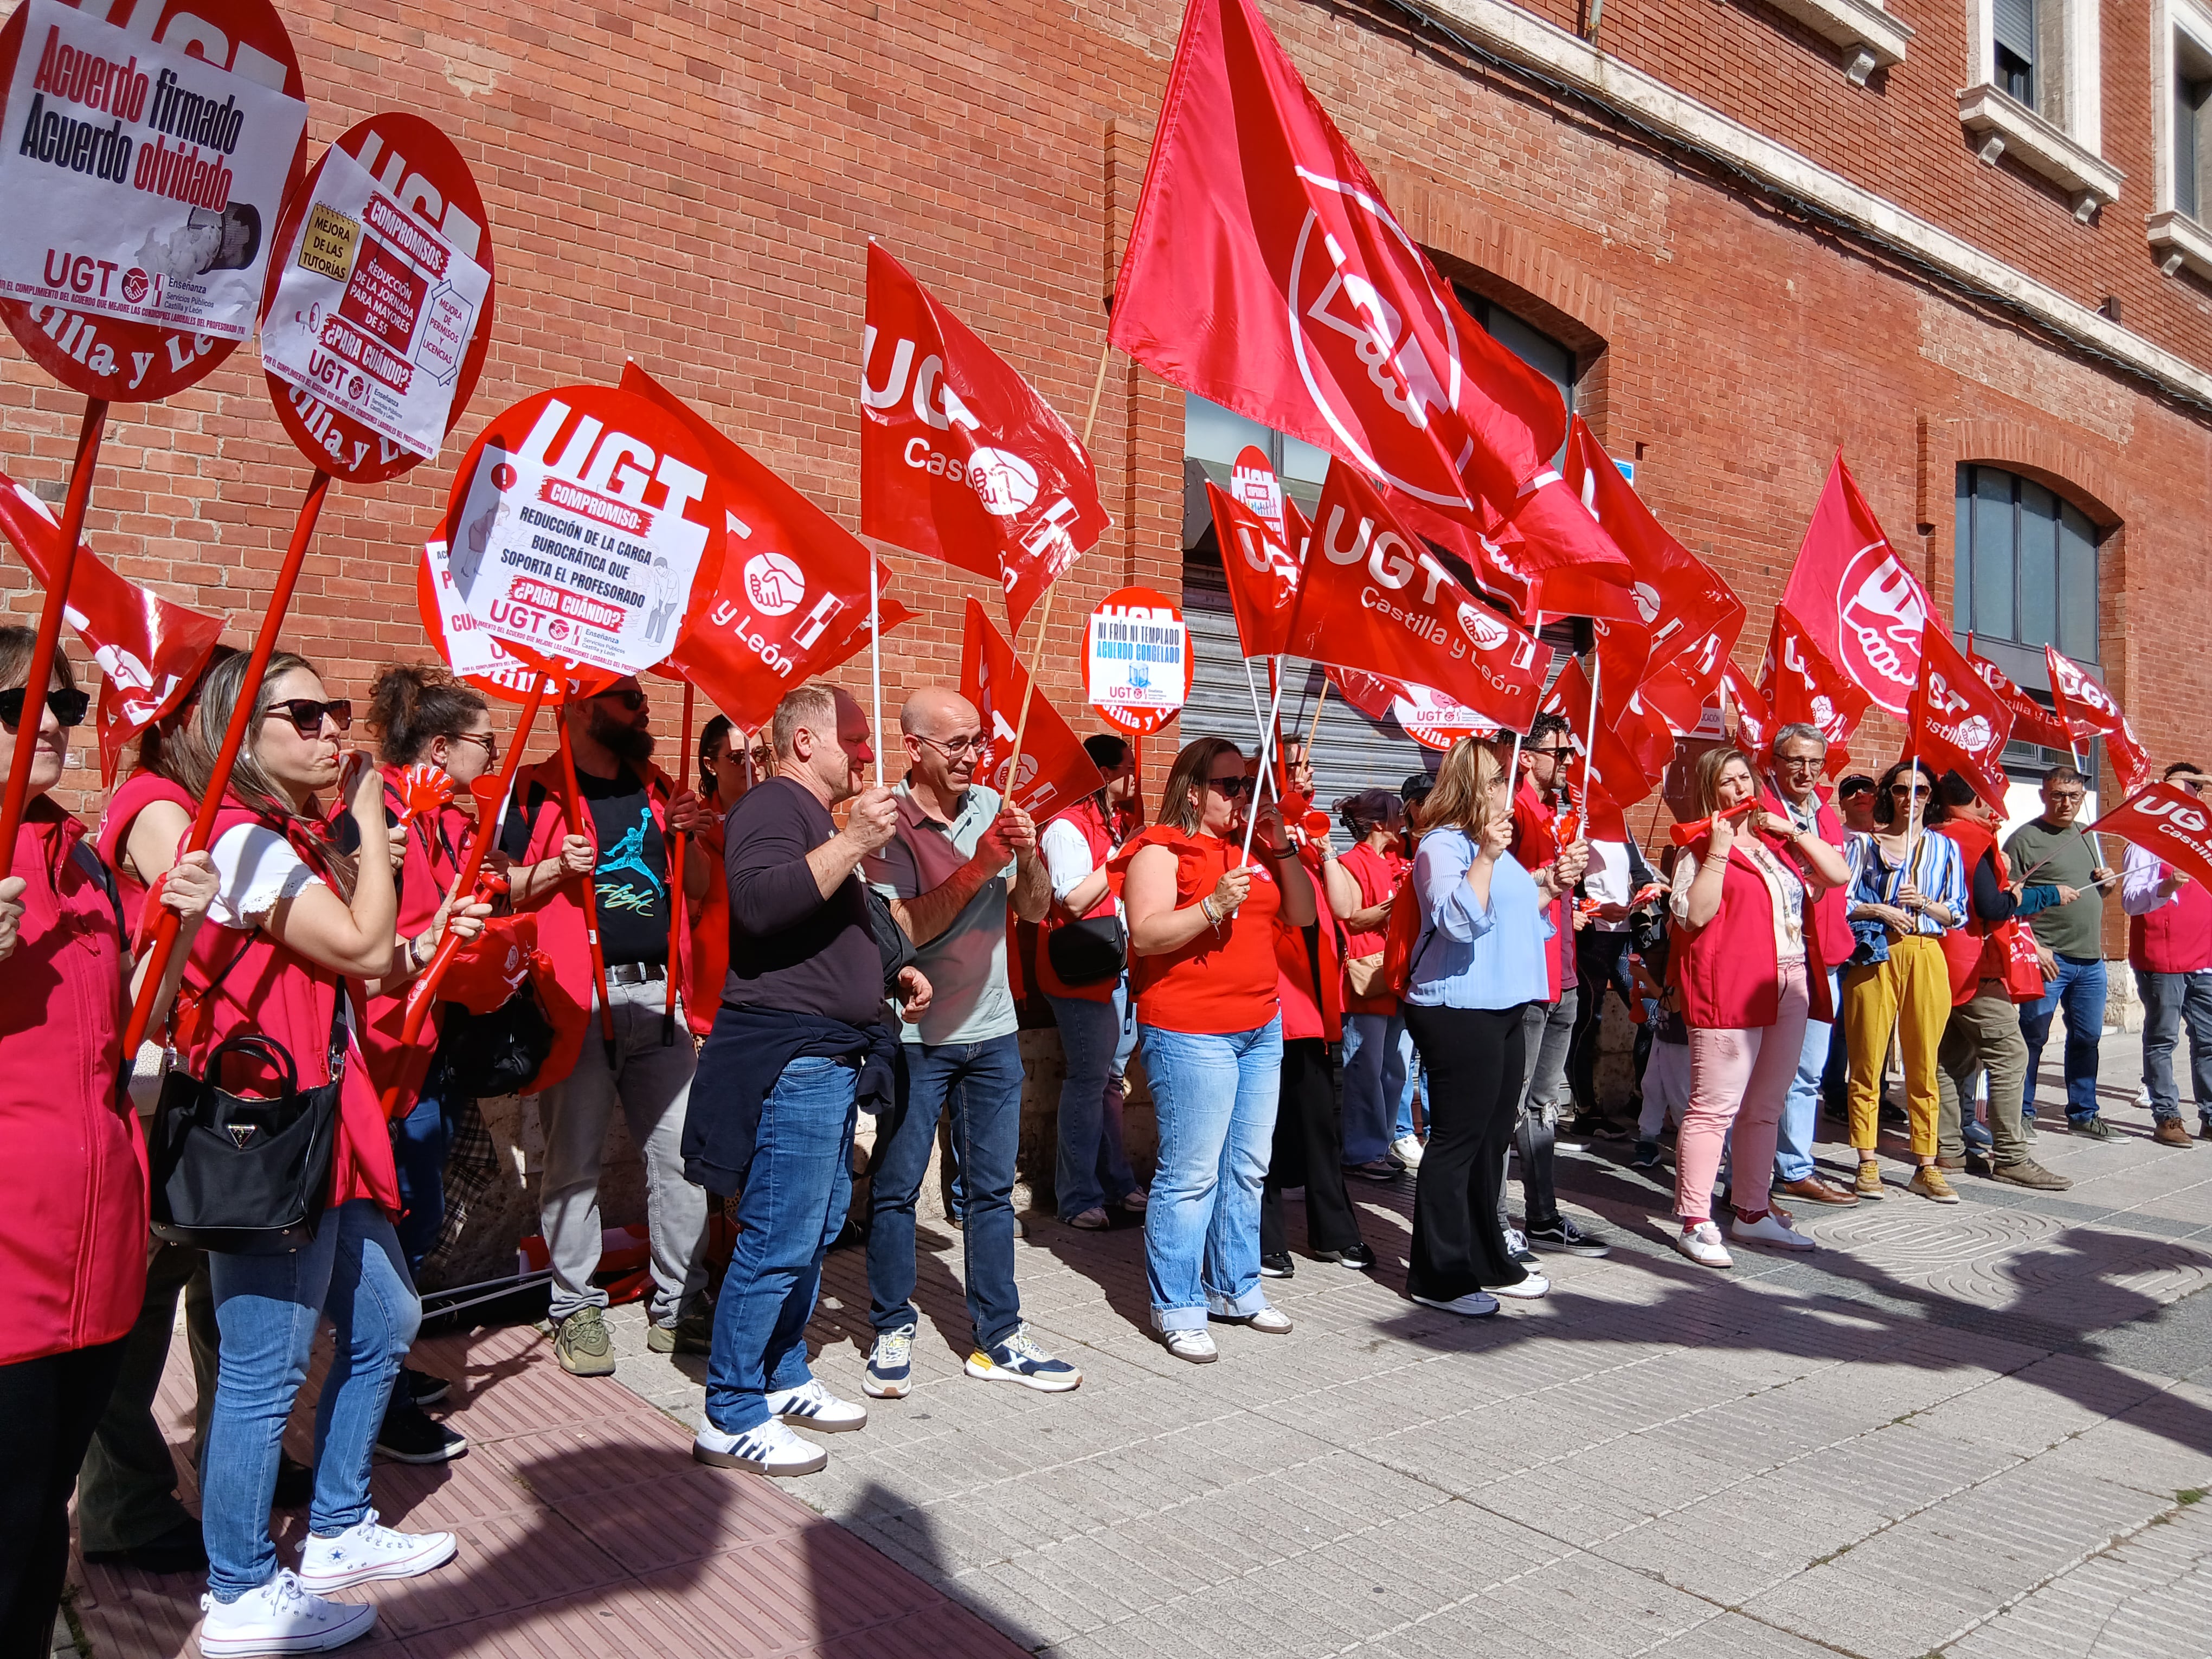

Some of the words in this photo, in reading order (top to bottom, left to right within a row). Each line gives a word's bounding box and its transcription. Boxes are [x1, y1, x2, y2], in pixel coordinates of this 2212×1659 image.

[33, 24, 149, 123] Acuerdo
[148, 68, 244, 156] firmado
[20, 93, 133, 184] Acuerdo
[133, 134, 233, 214] olvidado
[314, 216, 350, 242] MEJORA
[370, 200, 444, 271] COMPROMISOS:
[313, 236, 325, 252] DE
[326, 240, 344, 259] LAS
[43, 248, 119, 297] UGT
[303, 252, 346, 279] TUTORÍAS
[367, 260, 412, 301] REDUCCIÓN
[7, 282, 14, 291] EL
[15, 282, 58, 299] CUMPLIMIENTO
[60, 292, 69, 301] DEL
[70, 294, 95, 307] ACUERDO
[97, 299, 107, 309] QUE
[108, 301, 130, 313] MEJORE
[131, 305, 141, 315] LAS
[166, 292, 190, 303] Servicios
[191, 297, 214, 308] Públicos
[168, 277, 207, 294] Enseñanza
[355, 269, 367, 286] DE
[365, 277, 377, 294] LA
[377, 287, 414, 320] JORNADA
[164, 301, 183, 311] Castilla
[189, 305, 202, 314] León
[349, 284, 372, 308] PARA
[373, 300, 410, 333] MAYORES
[365, 312, 378, 329] DE
[377, 321, 389, 335] 55
[439, 298, 462, 321] MEJORA
[443, 314, 452, 326] DE
[429, 317, 459, 343] PERMISOS
[440, 336, 444, 345] Y
[325, 323, 363, 363] ¿PARA
[363, 344, 409, 388] CUÁNDO?
[423, 339, 452, 364] LICENCIAS
[128, 351, 155, 389] y
[308, 349, 349, 390] UGT
[349, 441, 370, 472] y
[517, 398, 708, 519] UGT
[550, 483, 642, 531] COMPROMISO:
[519, 506, 583, 541] REDUCCIÓN
[584, 528, 601, 548] DE
[600, 535, 615, 552] LA
[617, 537, 652, 565] CARGA
[531, 533, 606, 572] BUROCRÁTICA
[608, 558, 631, 581] QUE
[1323, 504, 1454, 605] UGT
[500, 548, 552, 578] SOPORTA
[555, 565, 567, 583] EL
[570, 568, 646, 608] PROFESORADO
[490, 599, 546, 634] UGT
[514, 582, 558, 609] ¿PARA
[561, 590, 622, 629] CUÁNDO?
[586, 628, 619, 644] Enseñanza
[711, 599, 737, 626] y
[734, 615, 793, 679] León
[1098, 622, 1107, 640] NI
[1110, 620, 1127, 641] FRÍO
[1130, 625, 1138, 642] NI
[1141, 626, 1179, 646] TEMPLADO
[1361, 586, 1448, 645] Castilla
[1449, 638, 1466, 659] y
[1471, 651, 1521, 696] León
[1110, 686, 1132, 699] UGT
[1144, 716, 1153, 731] y
[1417, 711, 1442, 721] UGT
